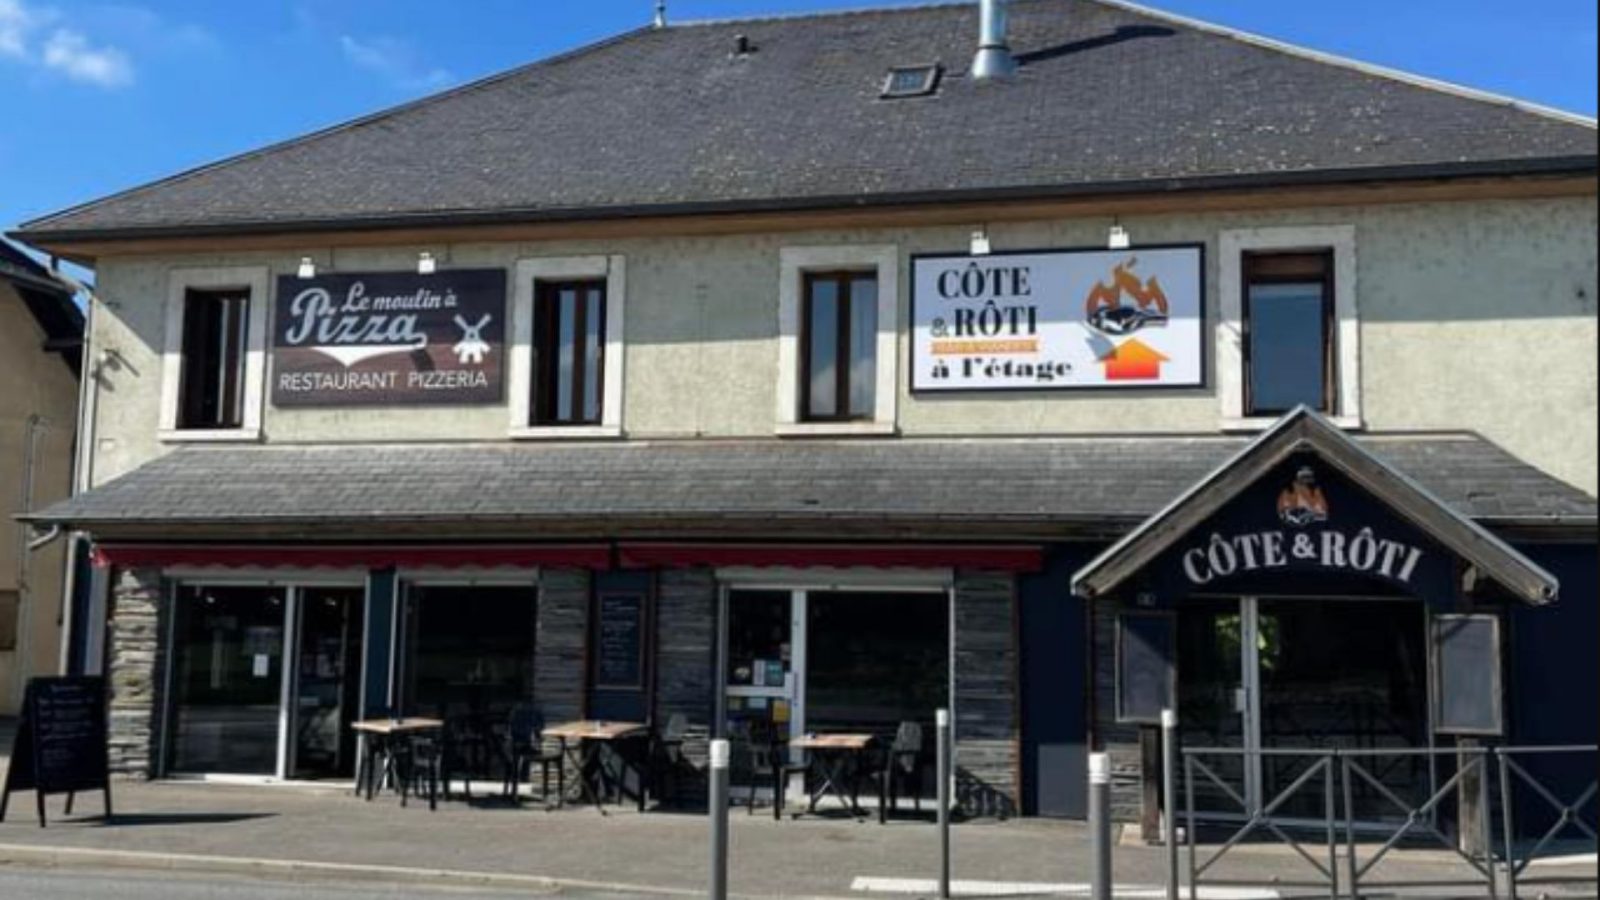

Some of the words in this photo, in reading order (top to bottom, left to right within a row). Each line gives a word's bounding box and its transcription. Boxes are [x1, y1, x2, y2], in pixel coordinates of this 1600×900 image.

[341, 281, 369, 312] Le
[372, 288, 441, 311] moulin
[444, 288, 457, 307] à
[938, 262, 1031, 299] CÔTE
[285, 287, 428, 348] Pizza
[930, 318, 949, 337] &
[955, 300, 1038, 336] RÔTI
[279, 371, 397, 391] RESTAURANT
[407, 370, 488, 388] PIZZERIA
[931, 359, 949, 378] à
[962, 357, 1073, 380] l'étage
[1182, 530, 1287, 584] CÔTE
[1292, 533, 1317, 559] &
[1320, 526, 1423, 583] RÔTI
